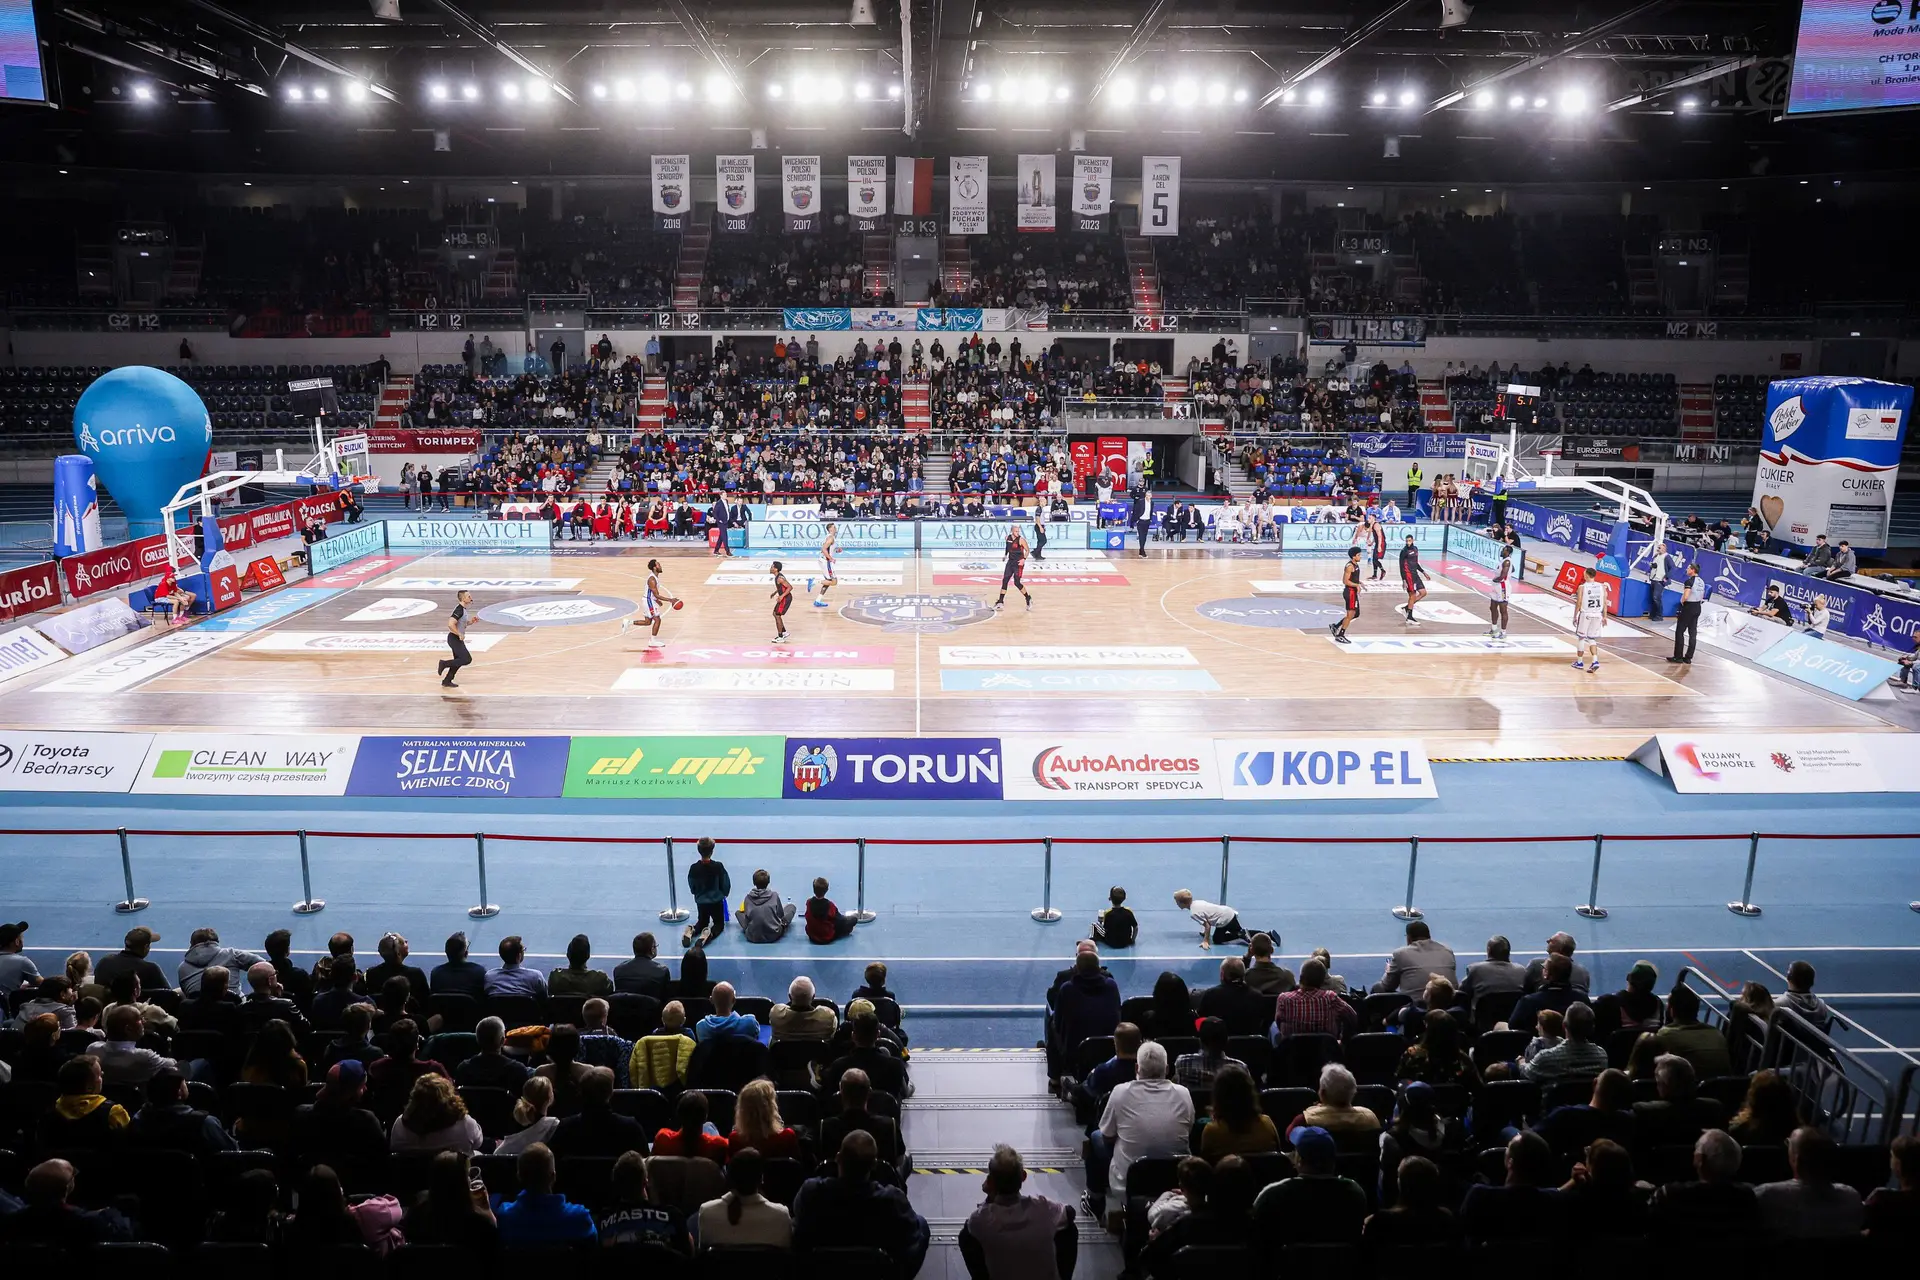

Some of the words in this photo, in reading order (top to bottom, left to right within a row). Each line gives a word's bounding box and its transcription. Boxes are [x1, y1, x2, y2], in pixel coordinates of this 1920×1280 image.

[1873, 27, 1904, 37] Moda
[1879, 55, 1894, 63] CH
[784, 158, 818, 166] WICEMISTRZ
[849, 159, 885, 168] WICEMISTRZ
[1077, 159, 1109, 167] WICEMISTRZ
[856, 168, 878, 176] POLSKI
[1083, 166, 1102, 174] POLSKI
[726, 173, 745, 181] POLSKI
[786, 174, 817, 182] SENIORÓW
[1152, 193, 1169, 226] 5
[663, 218, 681, 229] 2019
[727, 219, 746, 230] 2018
[793, 219, 811, 230] 2017
[859, 220, 875, 231] 2014
[900, 221, 915, 233] J3
[920, 221, 937, 233] K3
[1080, 220, 1100, 230] 2023
[1363, 238, 1381, 250] M3
[1688, 238, 1708, 250] N3
[107, 314, 131, 327] G2
[138, 314, 160, 327] H2
[419, 314, 438, 327] H2
[683, 313, 699, 326] J2
[807, 311, 842, 324] arriva
[944, 312, 975, 325] rriva
[1133, 316, 1151, 328] K2
[1160, 316, 1178, 329] L2
[1331, 320, 1405, 340] ULTRAS
[1666, 322, 1688, 335] M2
[1696, 322, 1718, 335] N2
[1172, 403, 1191, 417] K1
[1774, 405, 1798, 424] Polski
[1775, 418, 1801, 434] Cukier
[100, 423, 176, 446] arriva
[416, 436, 475, 446] TORIMPEX
[344, 441, 364, 453] SUZUKI
[1475, 447, 1497, 459] SUZUKI
[1576, 447, 1622, 455] EUROBASKET
[1675, 444, 1696, 458] M1
[1709, 446, 1729, 460] N1
[1760, 467, 1794, 484] CUKIER
[1841, 478, 1886, 491] CUKIER
[309, 502, 337, 516] DACSA
[401, 521, 533, 539] AEROWATCH
[763, 523, 898, 540] AEROWATCH
[1297, 525, 1427, 542] AEROTCH
[318, 524, 379, 562] AEROWATCH
[782, 540, 809, 548] SWISS
[841, 540, 862, 548] SINCE
[863, 540, 879, 548] 1910
[144, 547, 172, 563] ORLEN
[91, 556, 131, 580] arriva
[447, 579, 561, 587] ONDE
[220, 591, 236, 602] ORLEN
[1825, 594, 1848, 611] WAY
[1588, 599, 1602, 608] 21
[1248, 606, 1346, 617] arriva
[1410, 637, 1553, 650] ONDE
[741, 650, 859, 659] ORLEN
[1018, 651, 1092, 660] Bank
[1098, 650, 1186, 660] Pekao
[1803, 659, 1868, 684] arriva
[1039, 672, 1180, 686] arriva
[402, 740, 451, 748] NATURALNA
[452, 740, 478, 748] WODA
[478, 740, 526, 748] MINERALNA
[31, 744, 90, 759] Toyota
[1701, 751, 1742, 760] KUJAWY
[193, 750, 267, 767] CLEAN
[285, 750, 334, 767] WAY
[397, 749, 517, 780] SELENKA
[1050, 754, 1200, 773] AutoAndreas
[1704, 760, 1756, 768] POMORZE
[22, 760, 114, 778] Bednarscy
[846, 748, 999, 784] TORUŃ
[186, 771, 235, 782] tworzymy
[237, 771, 270, 783] czystą
[272, 771, 327, 783] przestrzeń
[586, 777, 632, 786] Mariusz
[634, 777, 693, 786] Kozłowski
[400, 776, 462, 791] WIENIEC
[465, 775, 510, 794] ZDRÓJ
[1074, 781, 1140, 791] TRANSPORT
[1145, 781, 1204, 791] SPEDYCJA
[601, 1208, 669, 1231] MIASTO
